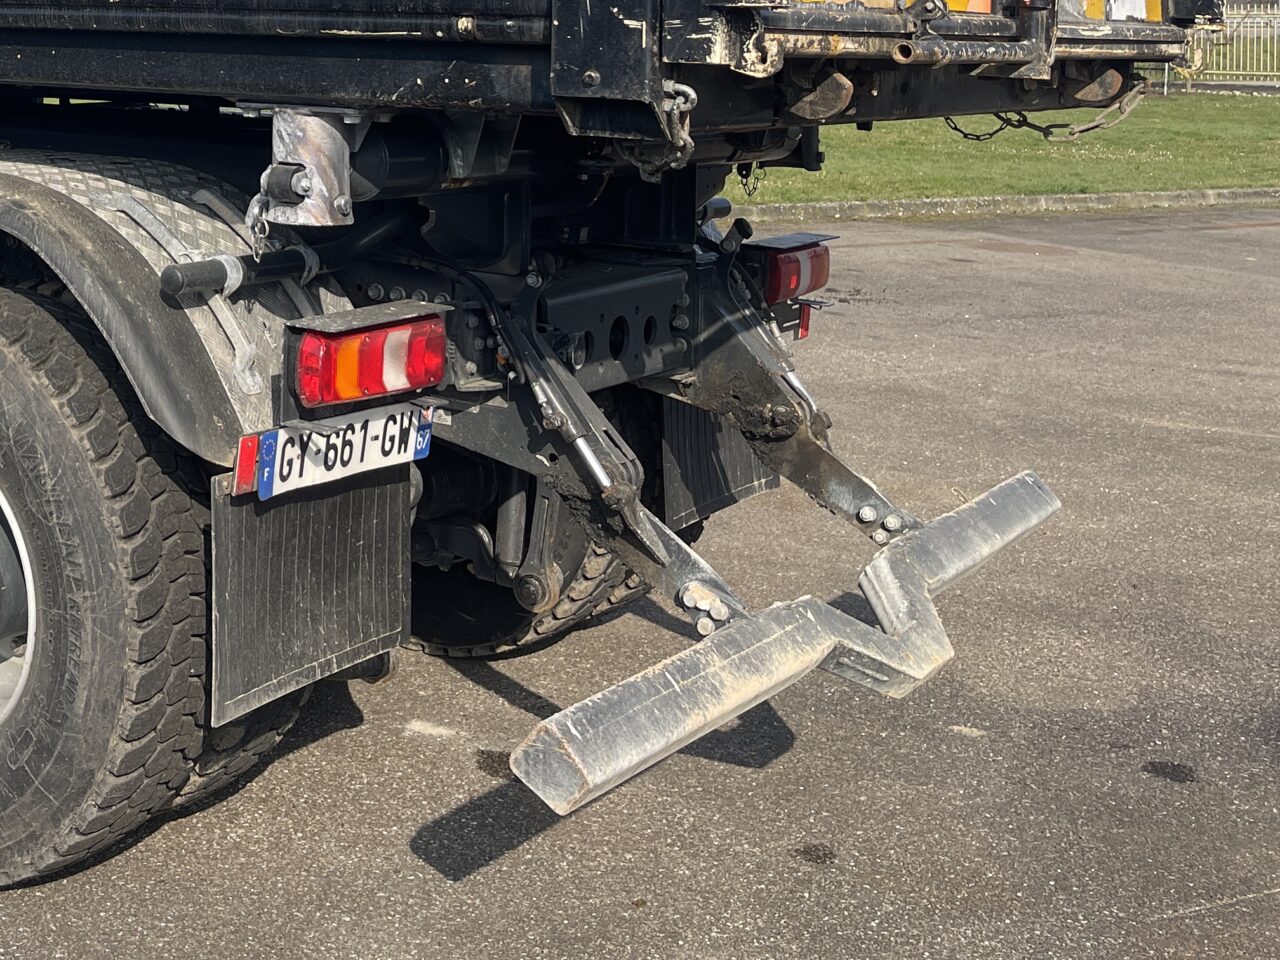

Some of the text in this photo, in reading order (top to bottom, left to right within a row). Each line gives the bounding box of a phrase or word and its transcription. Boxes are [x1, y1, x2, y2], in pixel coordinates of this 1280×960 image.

[263, 467, 270, 482] F
[278, 410, 414, 483] GY-661-GW
[416, 429, 430, 449] 67
